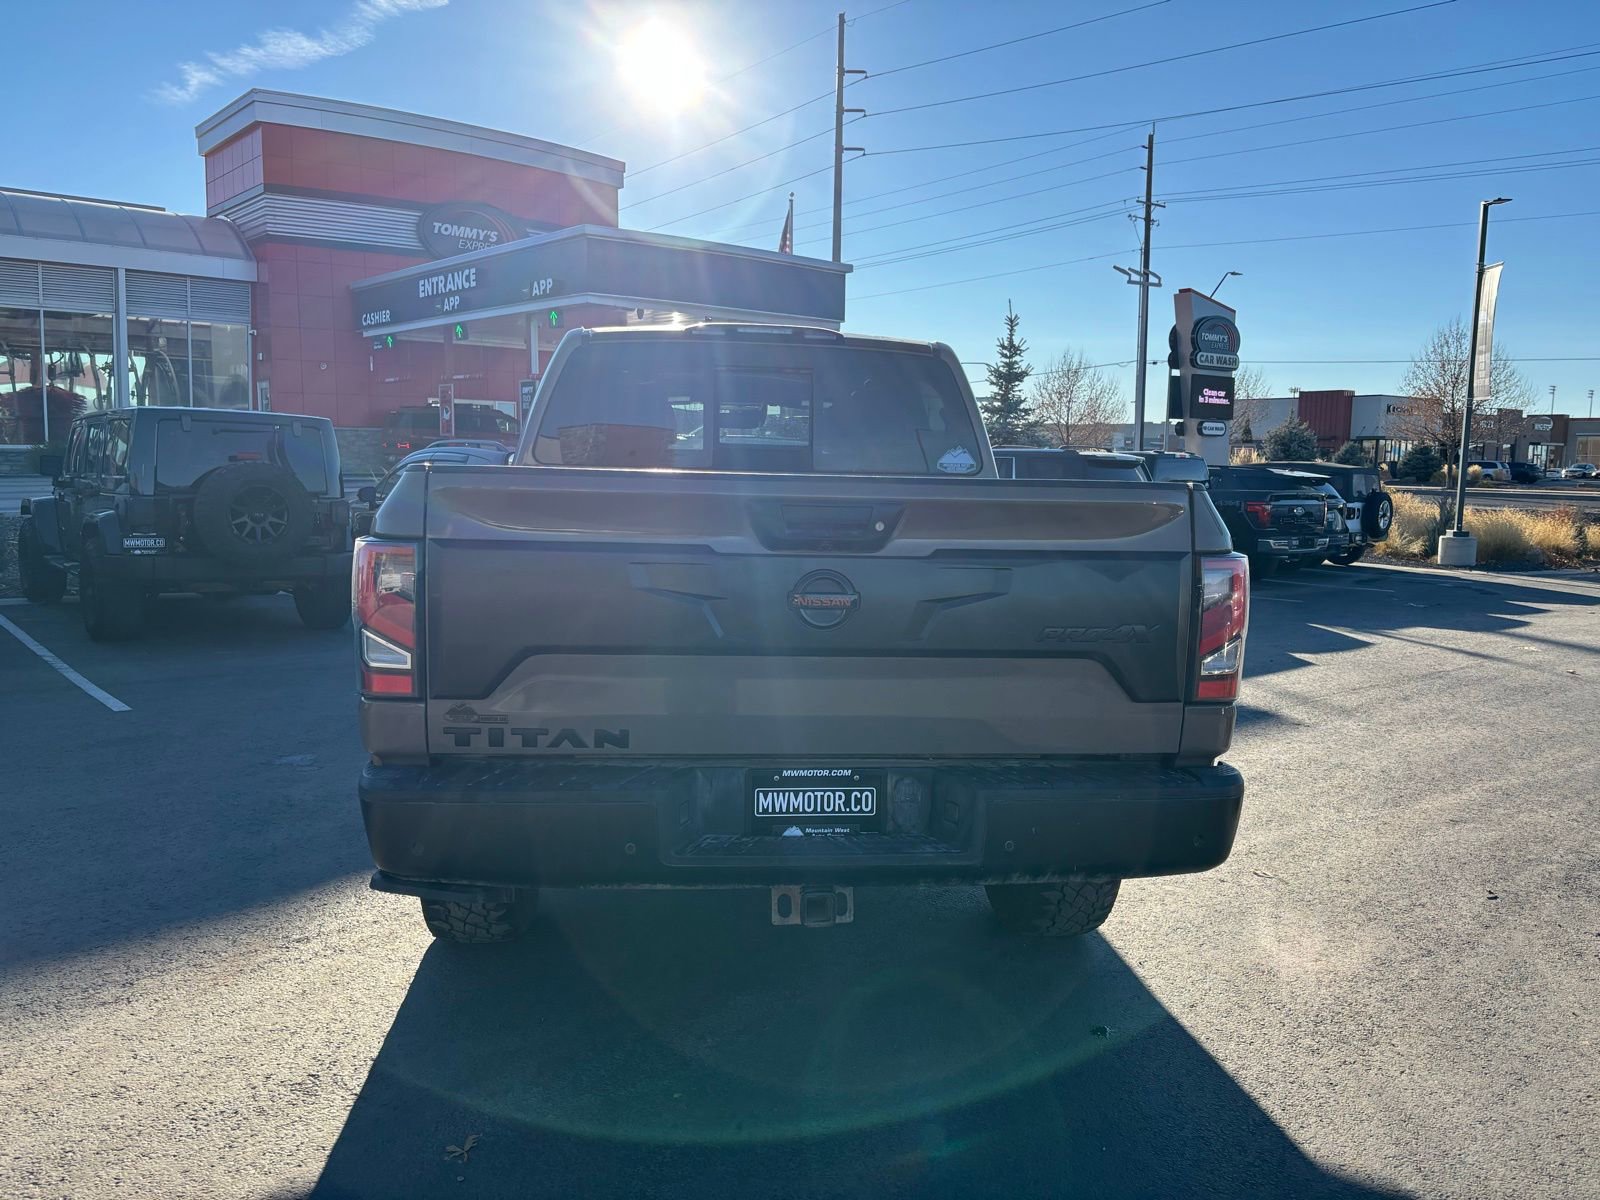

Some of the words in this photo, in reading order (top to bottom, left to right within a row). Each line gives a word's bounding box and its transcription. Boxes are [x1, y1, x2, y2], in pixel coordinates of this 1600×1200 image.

[433, 222, 498, 242] TOMMY'S
[419, 268, 476, 297] ENTRANCE
[532, 278, 553, 296] APP
[443, 296, 460, 312] APP
[362, 309, 391, 326] CASHIER
[1201, 333, 1228, 342] TOMMY'S
[1200, 354, 1214, 364] CAR
[1216, 356, 1237, 367] WASH
[798, 596, 852, 607] NISSAN
[443, 727, 630, 749] TITAN
[782, 769, 852, 777] MWMOTOR.COM
[758, 791, 872, 813] MWMOTOR.CO
